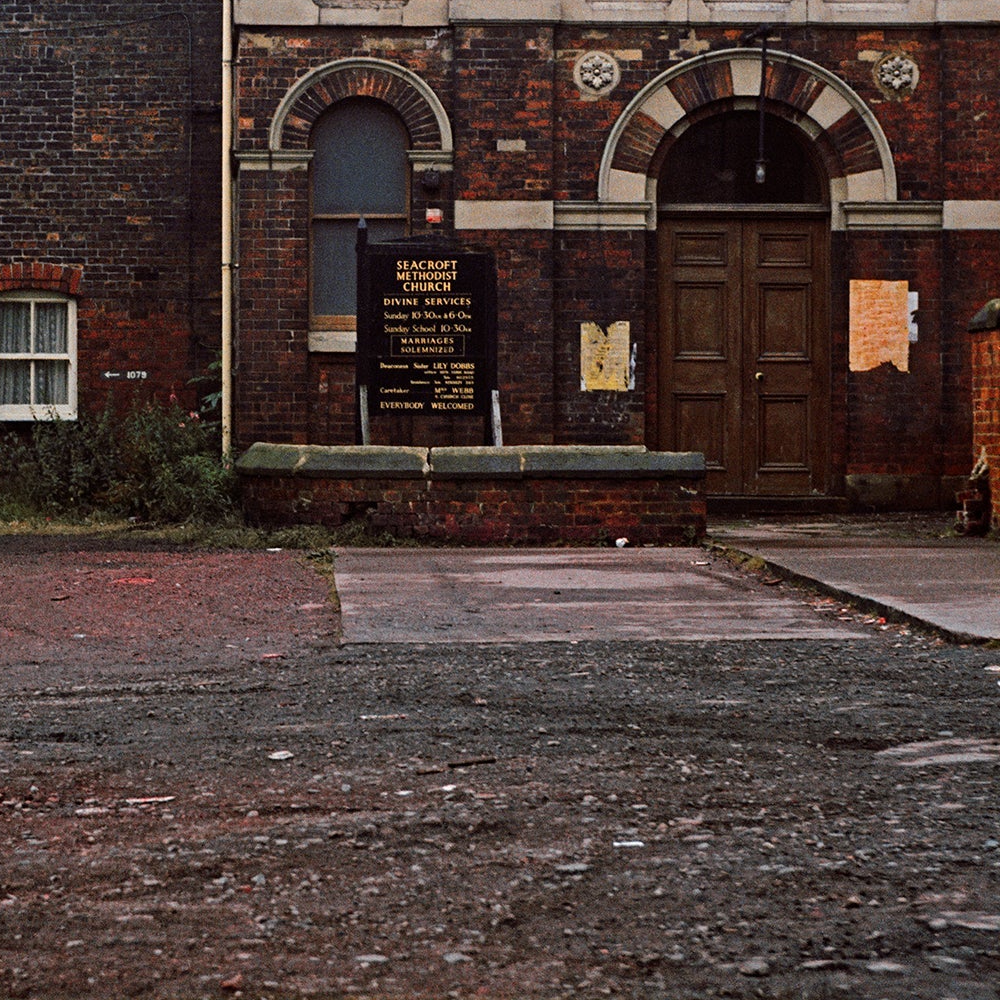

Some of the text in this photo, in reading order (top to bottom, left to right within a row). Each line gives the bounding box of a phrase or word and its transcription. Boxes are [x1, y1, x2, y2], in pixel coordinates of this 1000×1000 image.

[396, 260, 458, 270] SEACROFT
[396, 271, 458, 281] METHODIST
[402, 281, 451, 291] CHURCH
[383, 298, 471, 306] DIVINE SERVICES
[383, 311, 409, 321] Sunday
[383, 324, 410, 334] Sunday
[412, 324, 436, 333] School
[400, 337, 454, 345] MARRIAGES
[400, 346, 454, 354] SOLEMNIZED
[450, 362, 475, 370] DOBBS
[126, 370, 147, 379] 1079
[431, 402, 474, 410] WELCOMED
